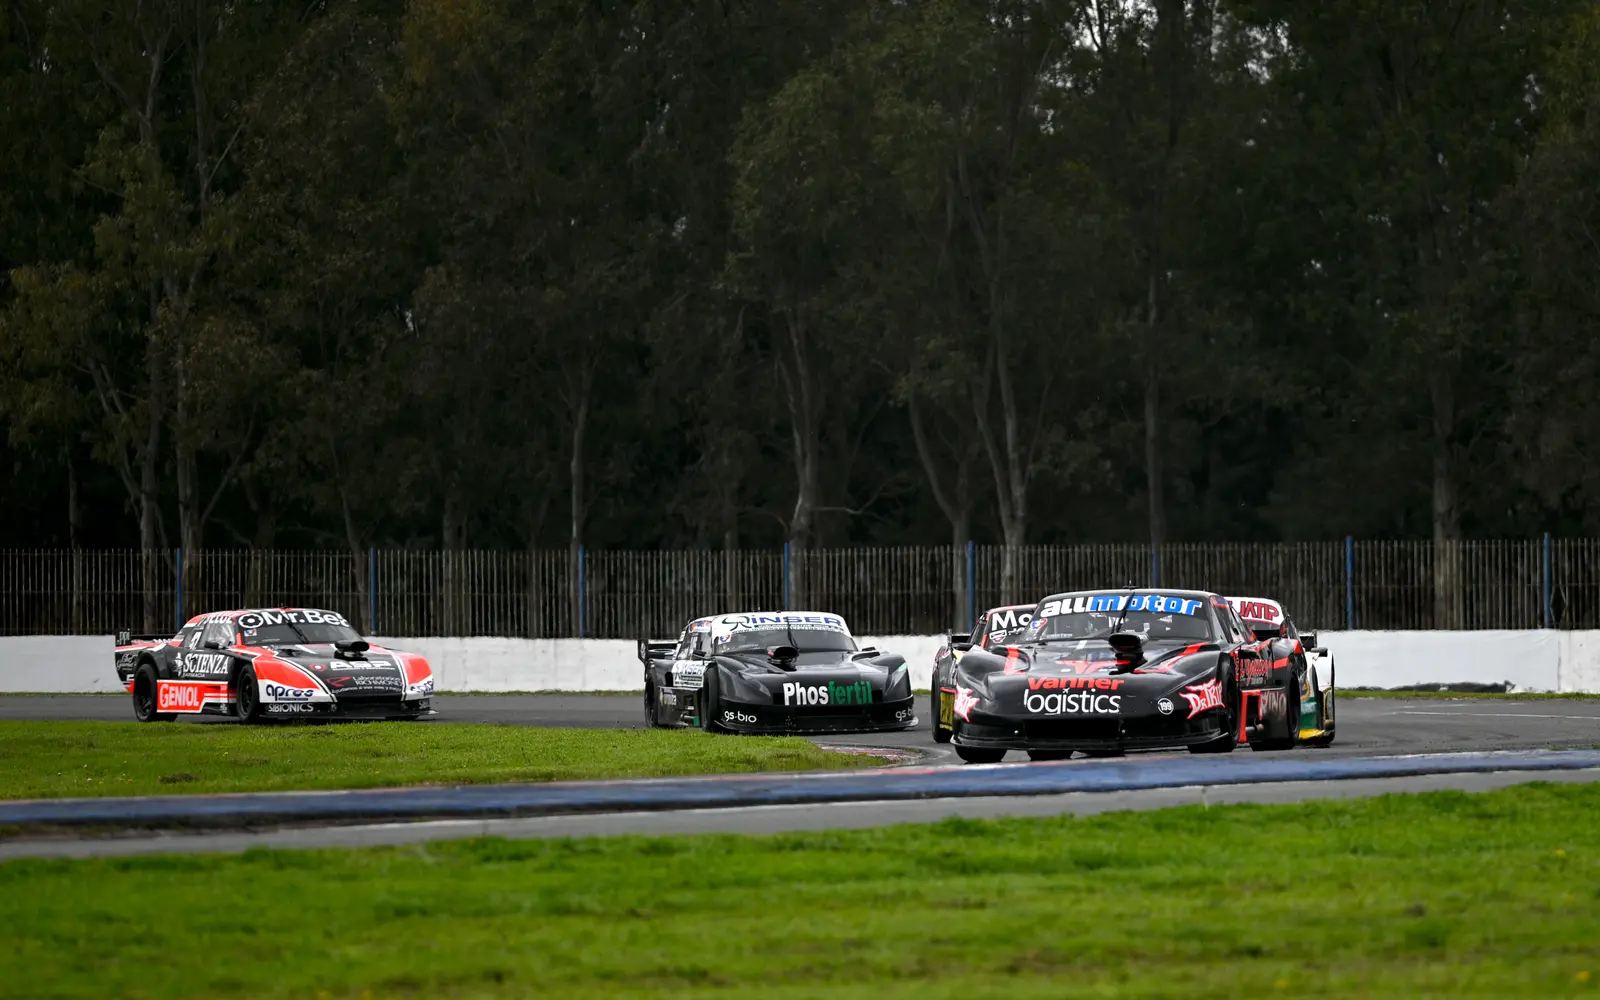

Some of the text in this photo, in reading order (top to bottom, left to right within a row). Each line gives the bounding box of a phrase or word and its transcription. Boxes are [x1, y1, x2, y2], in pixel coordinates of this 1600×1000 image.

[1040, 595, 1203, 618] allmotor
[183, 653, 229, 674] SCIENZA
[782, 680, 873, 706] Phosfertil
[1028, 676, 1125, 691] vanner
[159, 684, 200, 708] GENIOL
[268, 703, 314, 712] SIBIONICS
[1023, 688, 1122, 715] logistics
